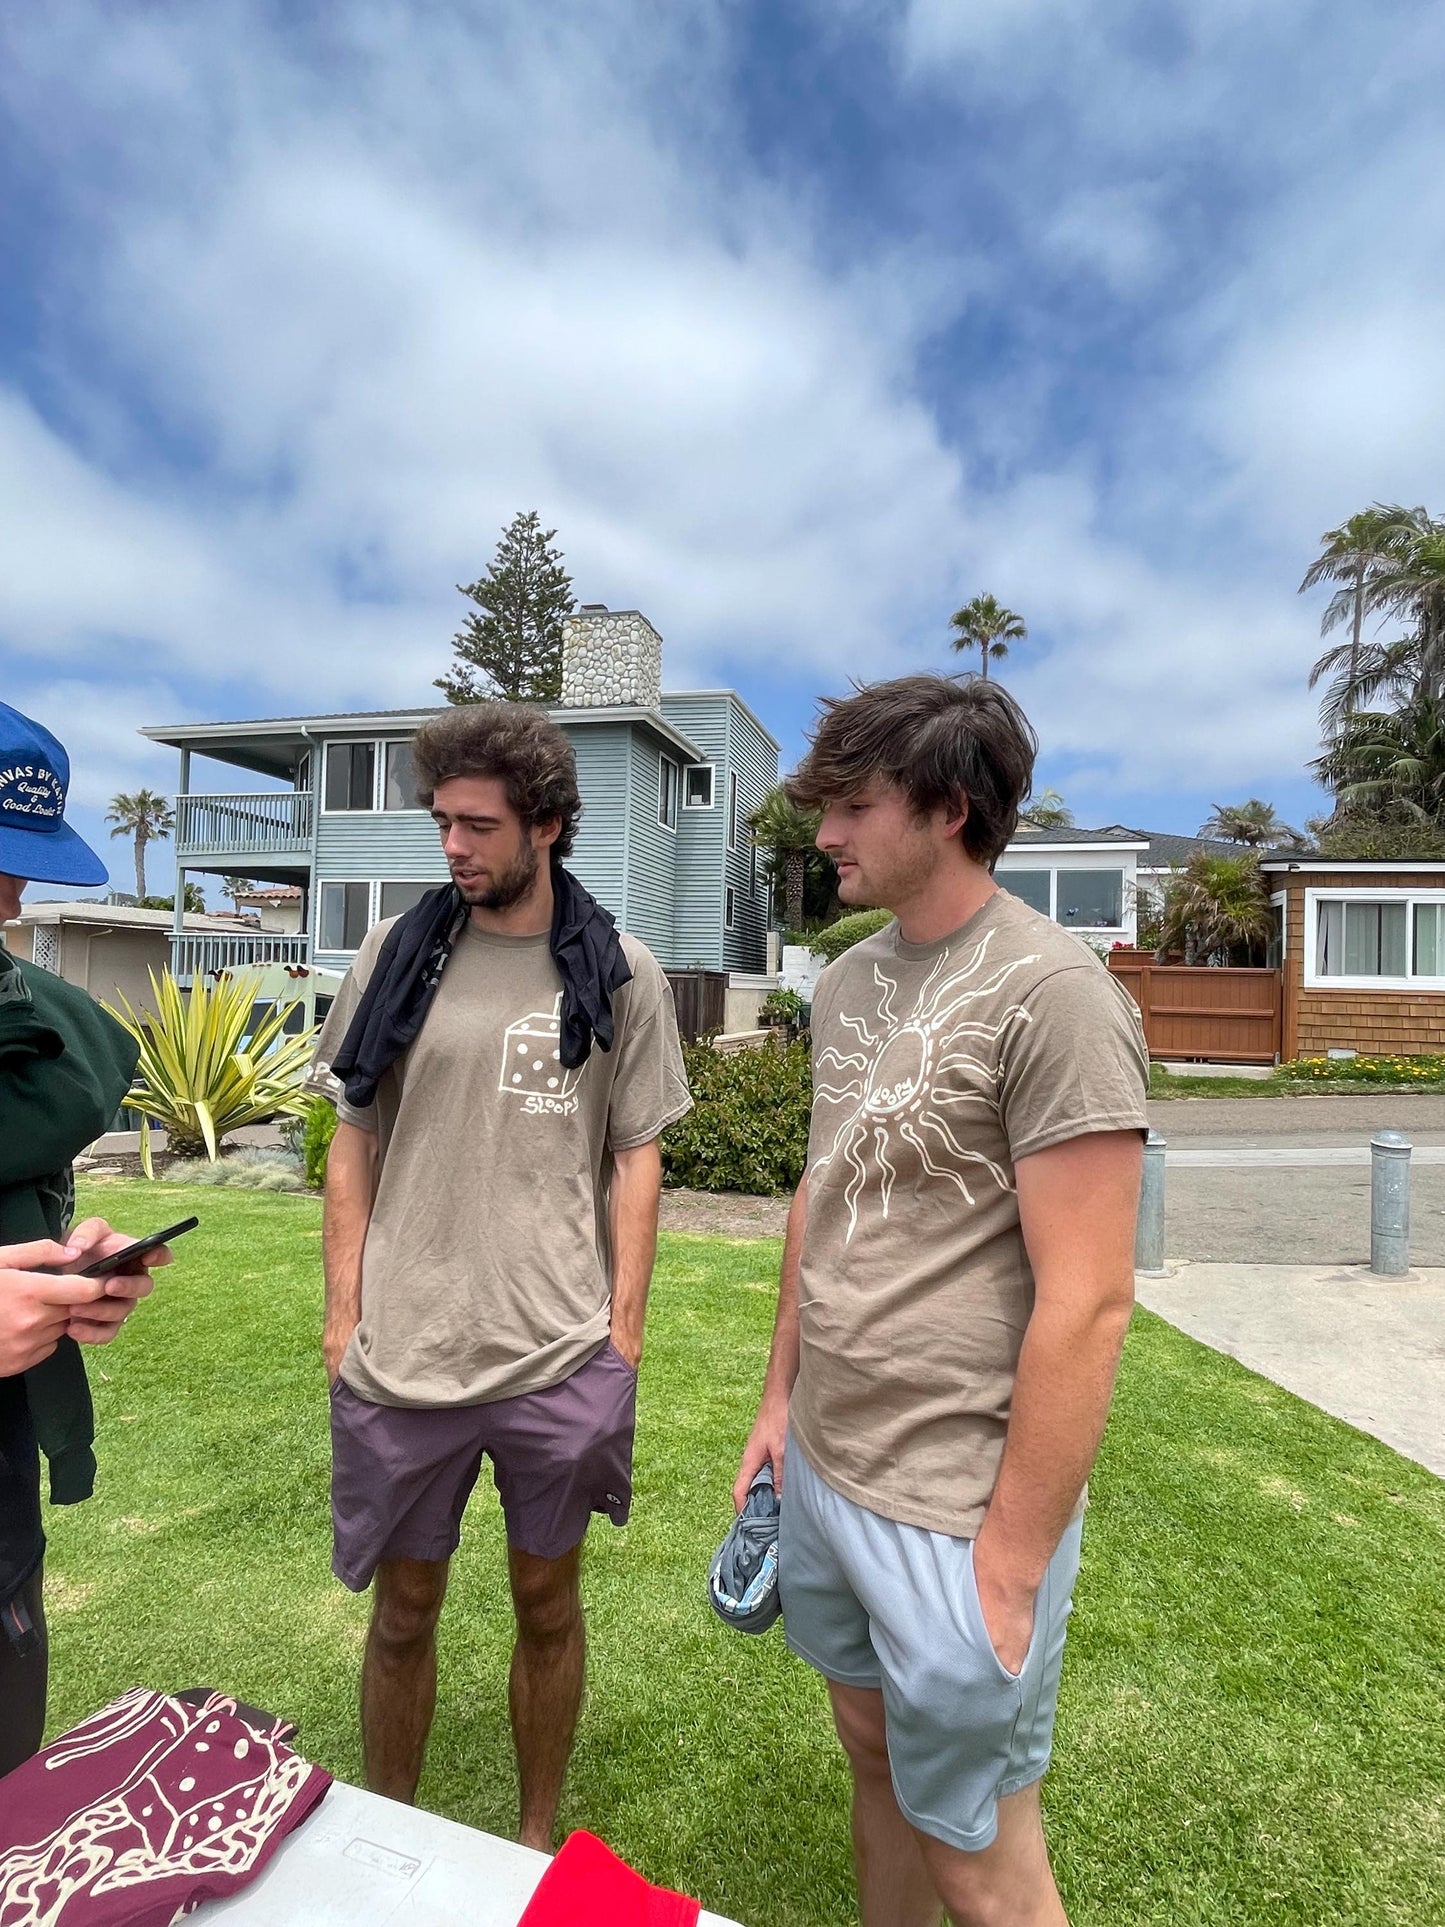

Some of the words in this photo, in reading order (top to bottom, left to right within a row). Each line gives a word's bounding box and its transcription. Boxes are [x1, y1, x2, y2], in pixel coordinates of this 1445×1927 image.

[0, 766, 33, 790] NVAS
[38, 769, 51, 781] BY
[17, 782, 51, 798] Quality
[3, 799, 31, 812] Good
